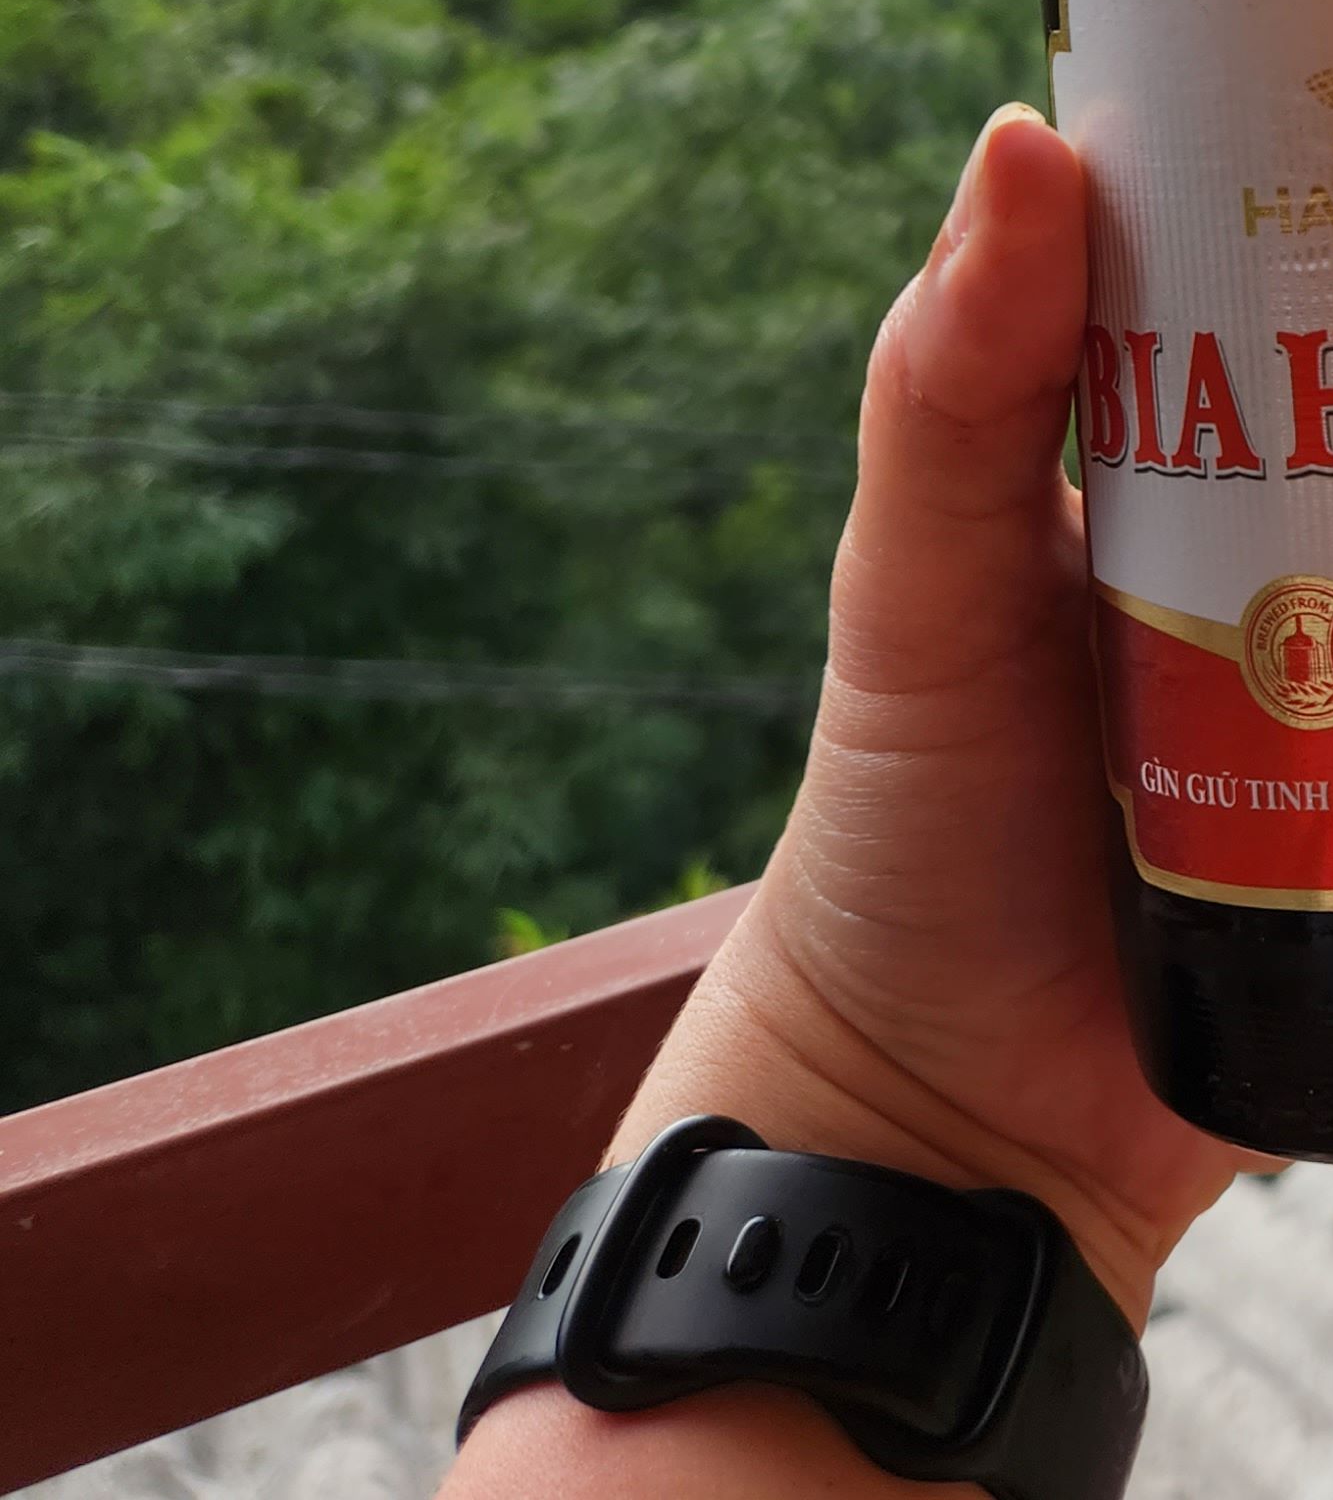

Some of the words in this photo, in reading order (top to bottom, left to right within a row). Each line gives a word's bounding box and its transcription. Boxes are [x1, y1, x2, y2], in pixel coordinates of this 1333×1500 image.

[1085, 323, 1266, 481] BIA
[1257, 602, 1290, 651] BREWED
[1289, 597, 1331, 613] FROM
[1140, 757, 1180, 799] GÌN
[1186, 770, 1239, 808] GIỮ
[1244, 779, 1330, 811] TINH
